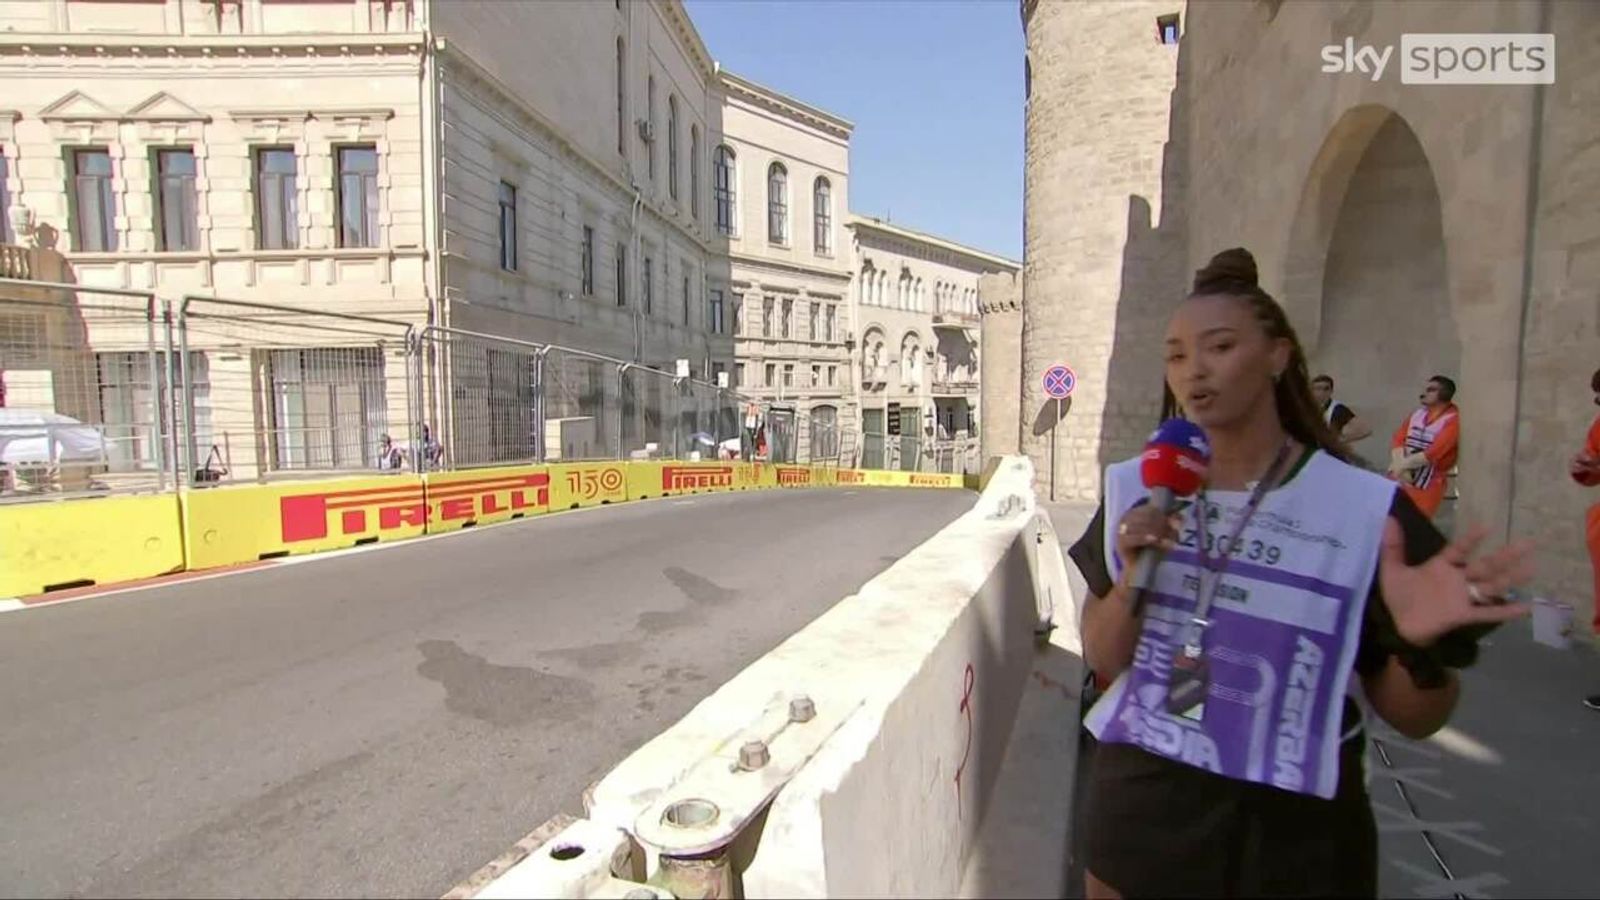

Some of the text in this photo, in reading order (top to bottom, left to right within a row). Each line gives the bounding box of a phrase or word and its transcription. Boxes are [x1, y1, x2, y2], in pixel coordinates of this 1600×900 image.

[566, 469, 622, 499] 150
[662, 466, 733, 490] PIRELLI
[280, 474, 550, 543] PIRELLI
